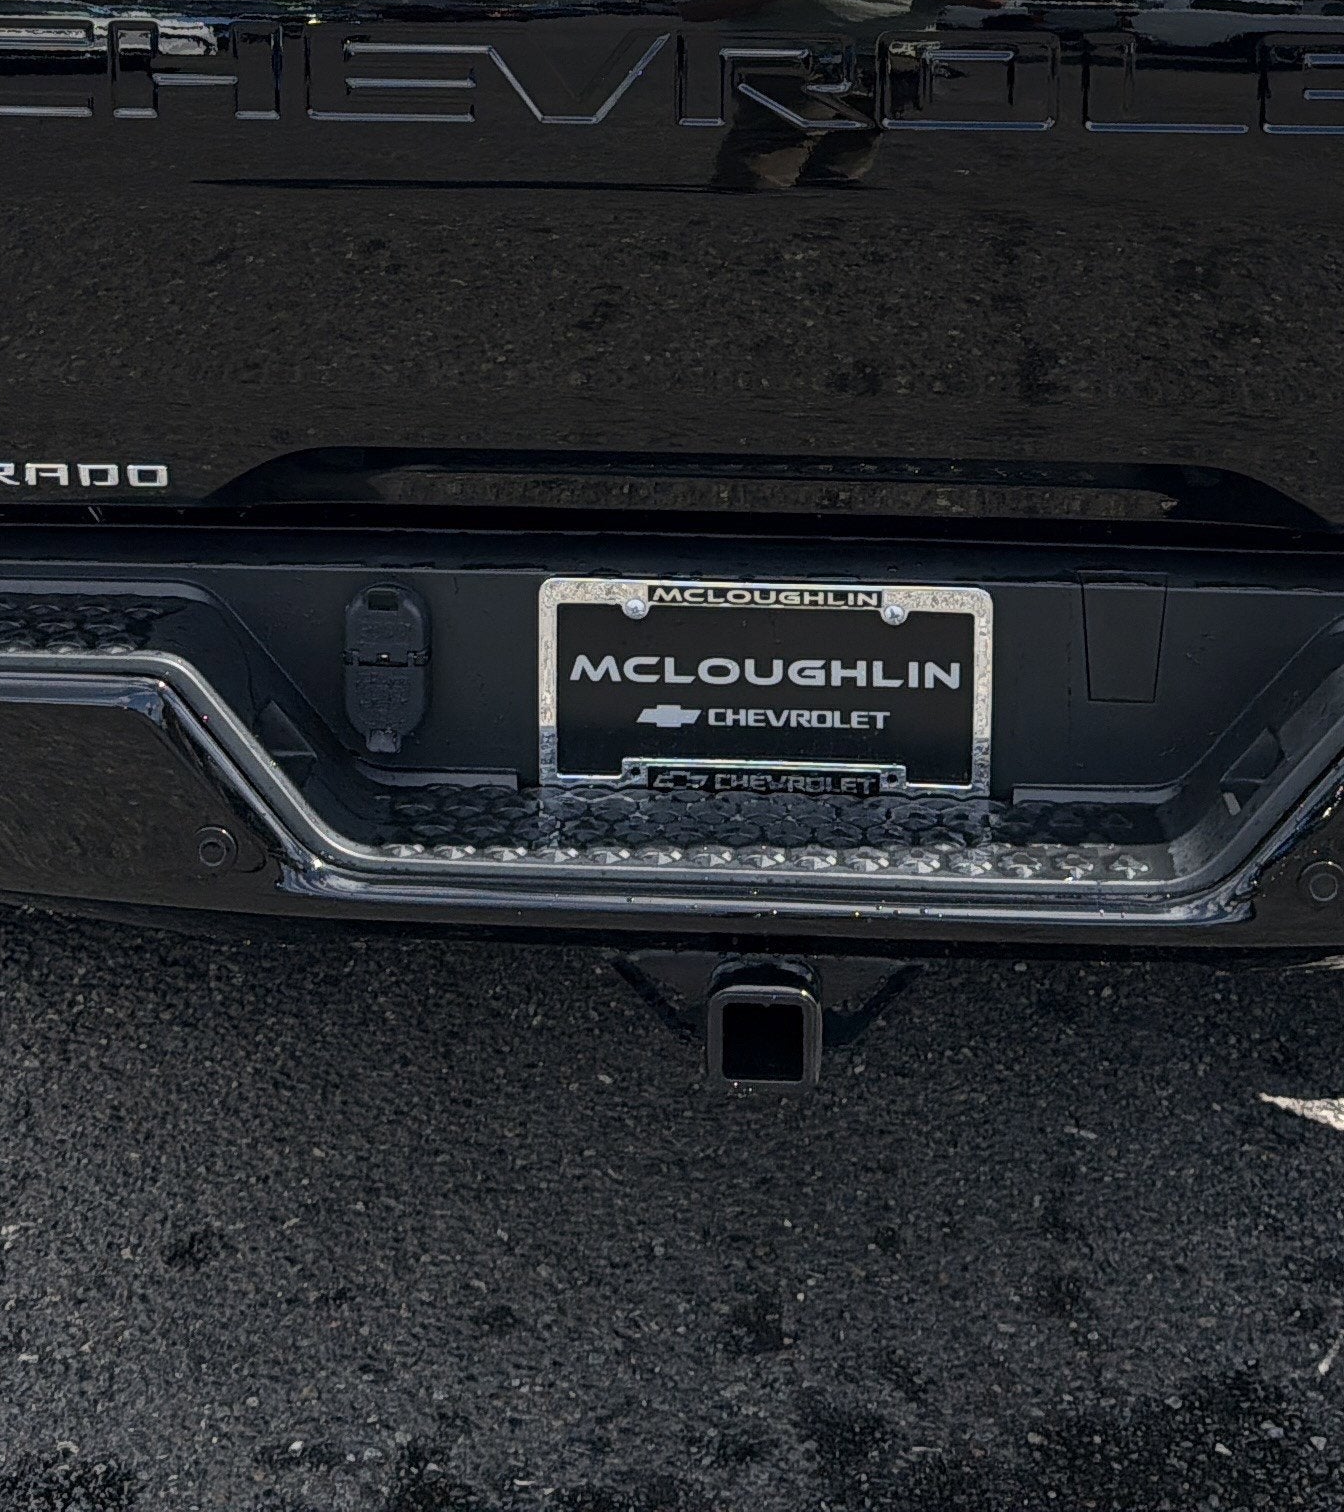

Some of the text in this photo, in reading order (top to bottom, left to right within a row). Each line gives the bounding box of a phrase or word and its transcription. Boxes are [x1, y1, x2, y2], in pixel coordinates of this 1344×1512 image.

[569, 654, 961, 690] MCLOUGHLIN
[707, 707, 891, 730] CHEVROLET
[714, 772, 877, 795] CHEVROLET
